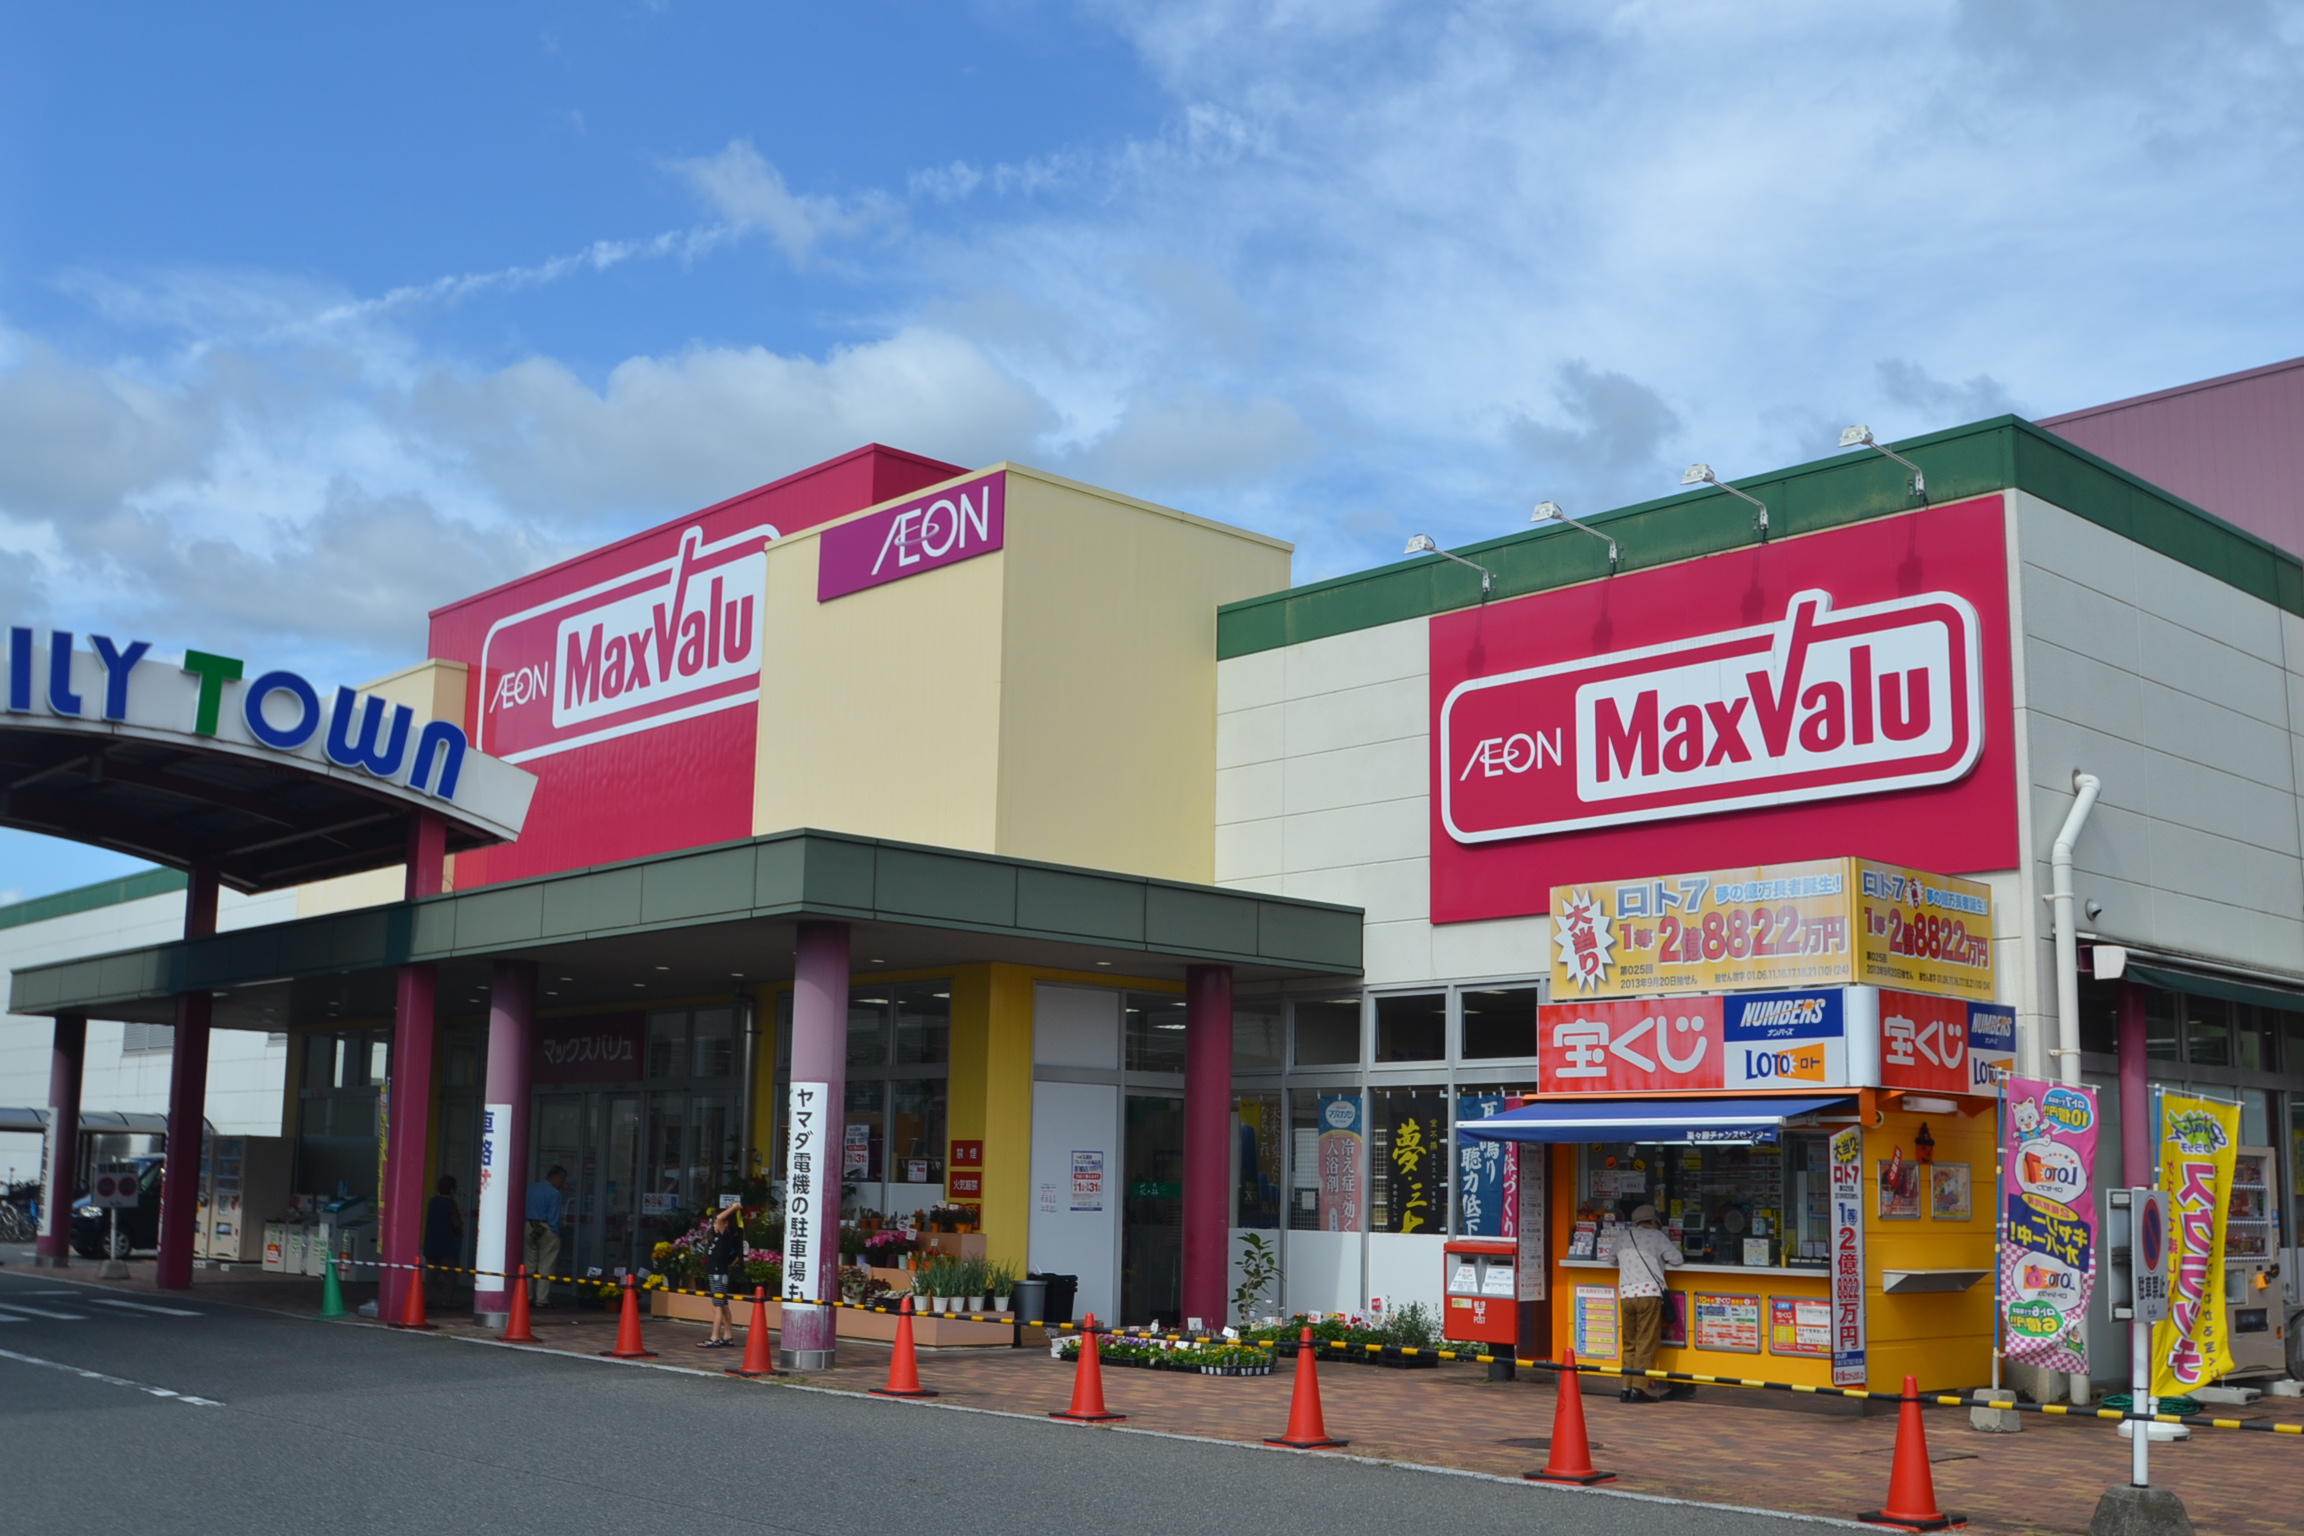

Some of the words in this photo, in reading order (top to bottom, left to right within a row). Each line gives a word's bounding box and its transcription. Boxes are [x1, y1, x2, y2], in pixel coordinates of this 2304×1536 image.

[564, 533, 755, 712] MaxValu
[1595, 600, 1932, 784] MaxValu
[1615, 876, 1710, 920] ロト7
[1862, 869, 1906, 902] ロト7
[1565, 903, 1600, 977] 大当り
[1739, 998, 1827, 1029] NUMBERS
[1971, 1012, 2013, 1038] NUMBERS
[542, 1034, 634, 1065] マックスバリュ
[1552, 1014, 1708, 1079] 宝くじ
[1884, 1013, 1964, 1070] 宝くじ
[1745, 1049, 1792, 1082] LOTO
[1473, 1315, 1486, 1325] POST
